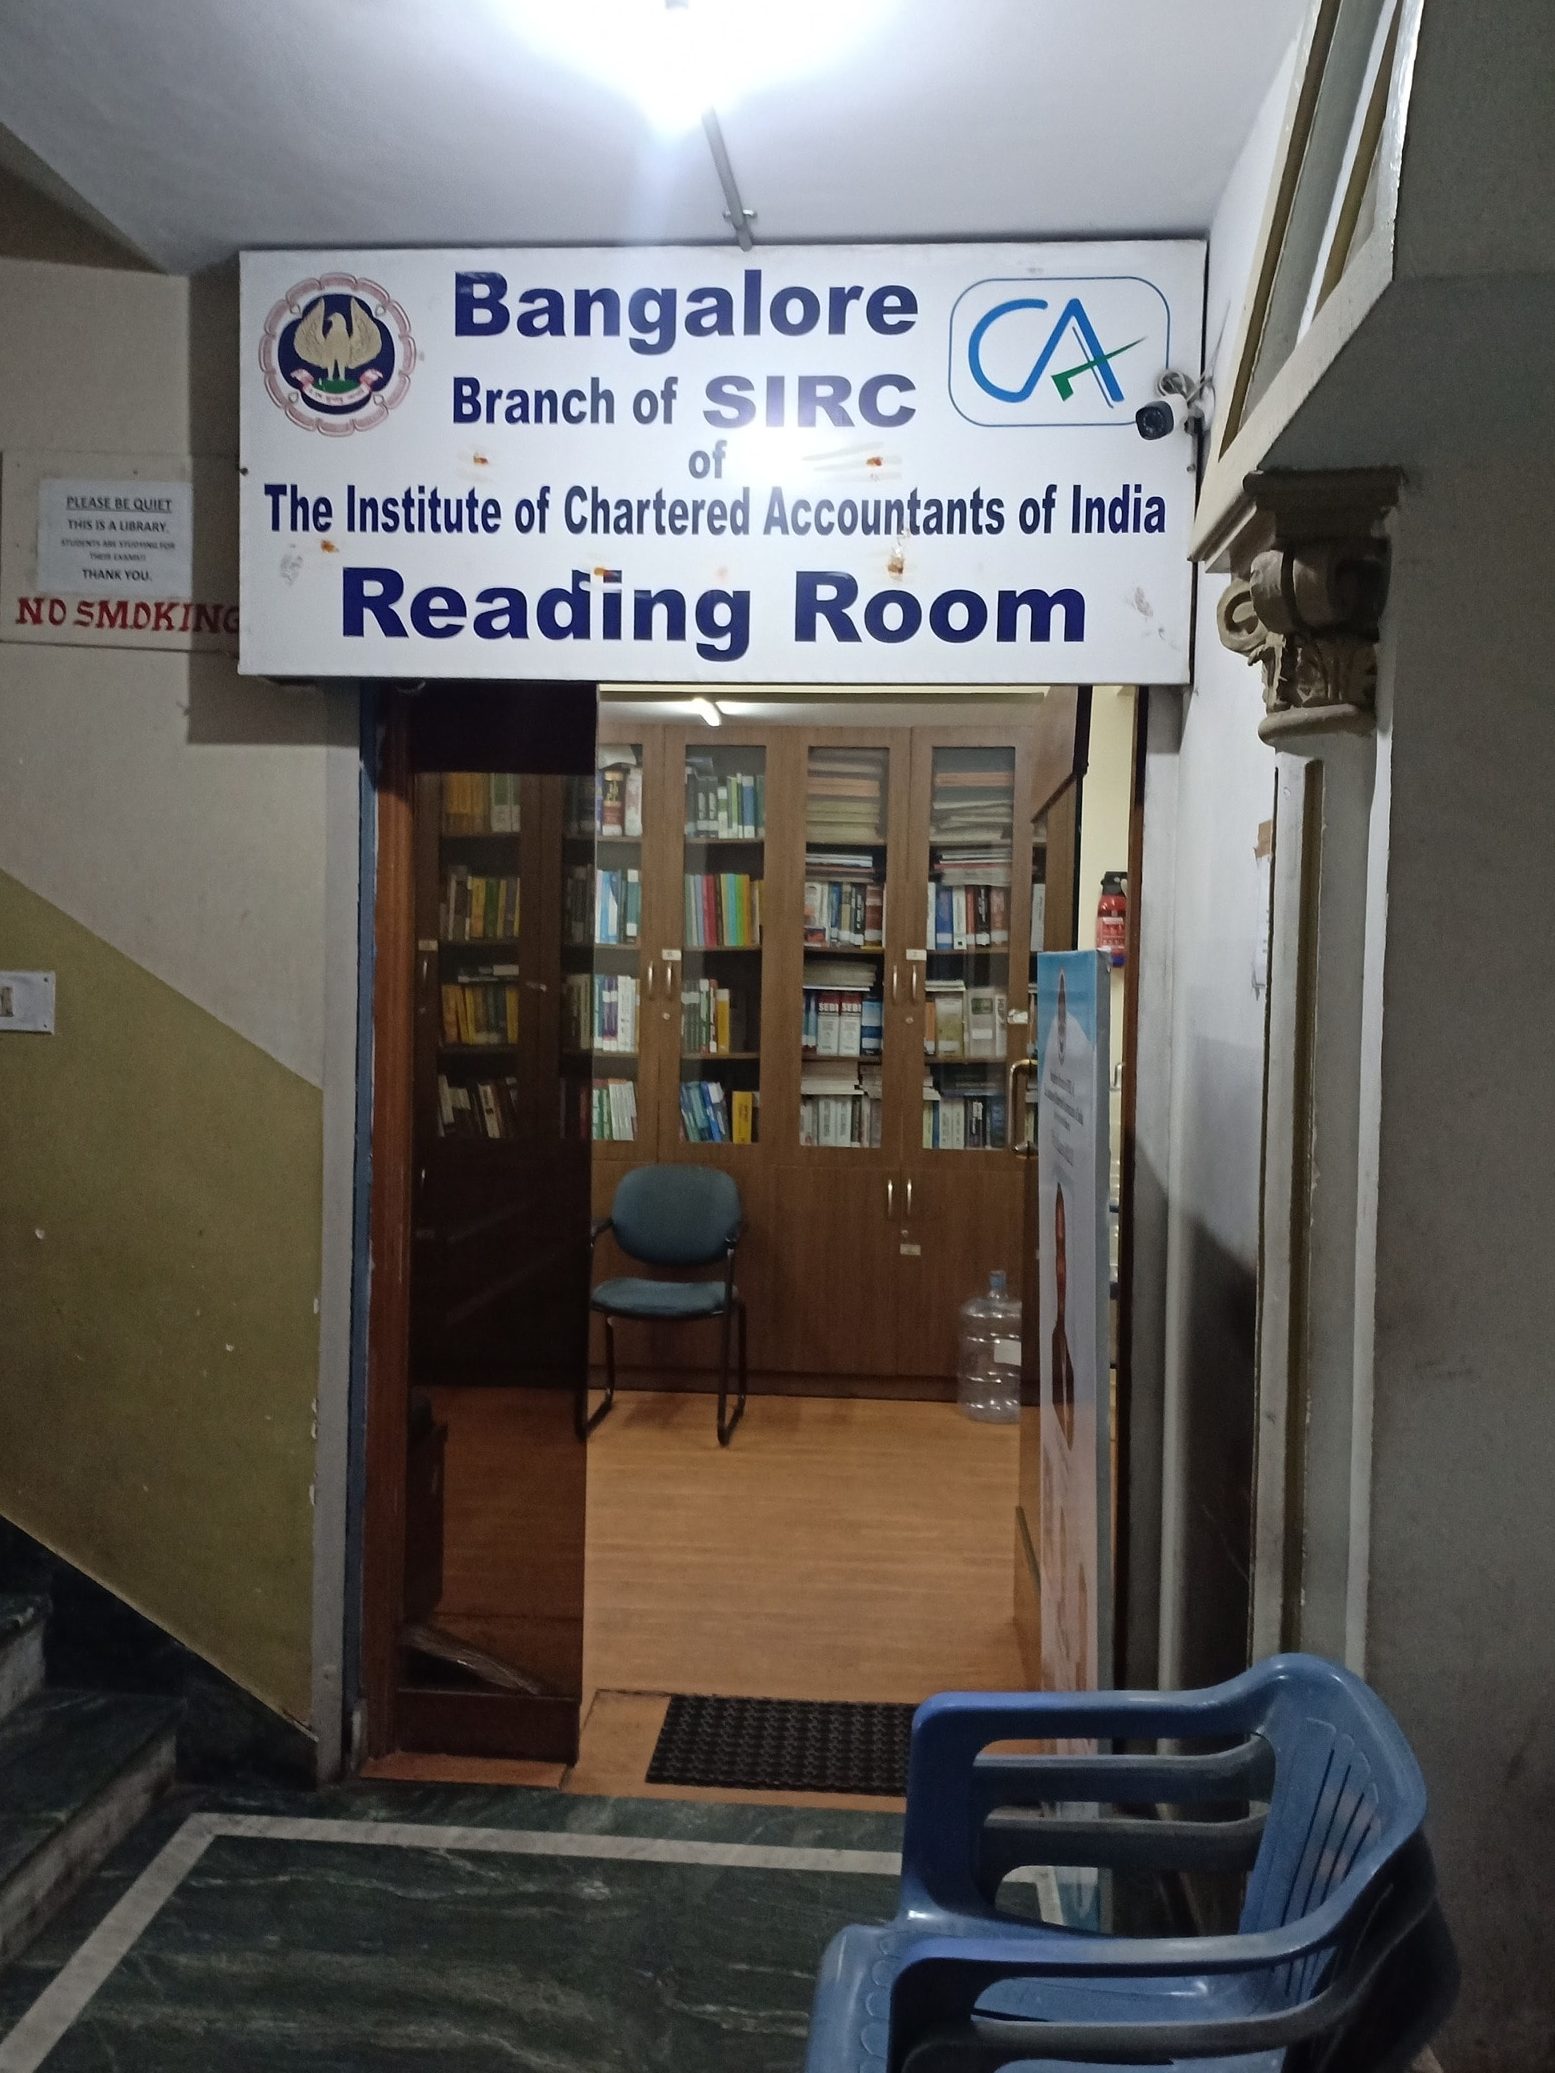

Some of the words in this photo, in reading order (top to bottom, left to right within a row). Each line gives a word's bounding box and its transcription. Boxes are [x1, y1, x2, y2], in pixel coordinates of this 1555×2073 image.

[454, 269, 919, 355] Bangalore
[453, 376, 615, 424] Branch
[632, 376, 677, 424] of
[702, 374, 917, 428] SIRC
[688, 440, 727, 479] of
[66, 495, 111, 510] PLEASE
[114, 497, 130, 510] BE
[133, 498, 173, 513] QUIET
[264, 484, 332, 533] The
[347, 485, 501, 534] Institute
[514, 486, 550, 534] of
[564, 486, 750, 536] Chartered
[763, 485, 1005, 537] Accountants
[1018, 484, 1057, 535] of
[1071, 483, 1166, 535] India
[61, 539, 101, 548] STUDENTS
[67, 519, 93, 530] THIS
[95, 519, 105, 531] IS
[108, 520, 117, 531] A
[119, 520, 170, 533] LIBRARY.
[82, 568, 121, 580] THANK
[124, 569, 153, 582] YOU.
[15, 597, 67, 626] NO
[73, 599, 239, 634] SMOKING
[342, 566, 751, 661] Reading
[795, 570, 1086, 643] Room
